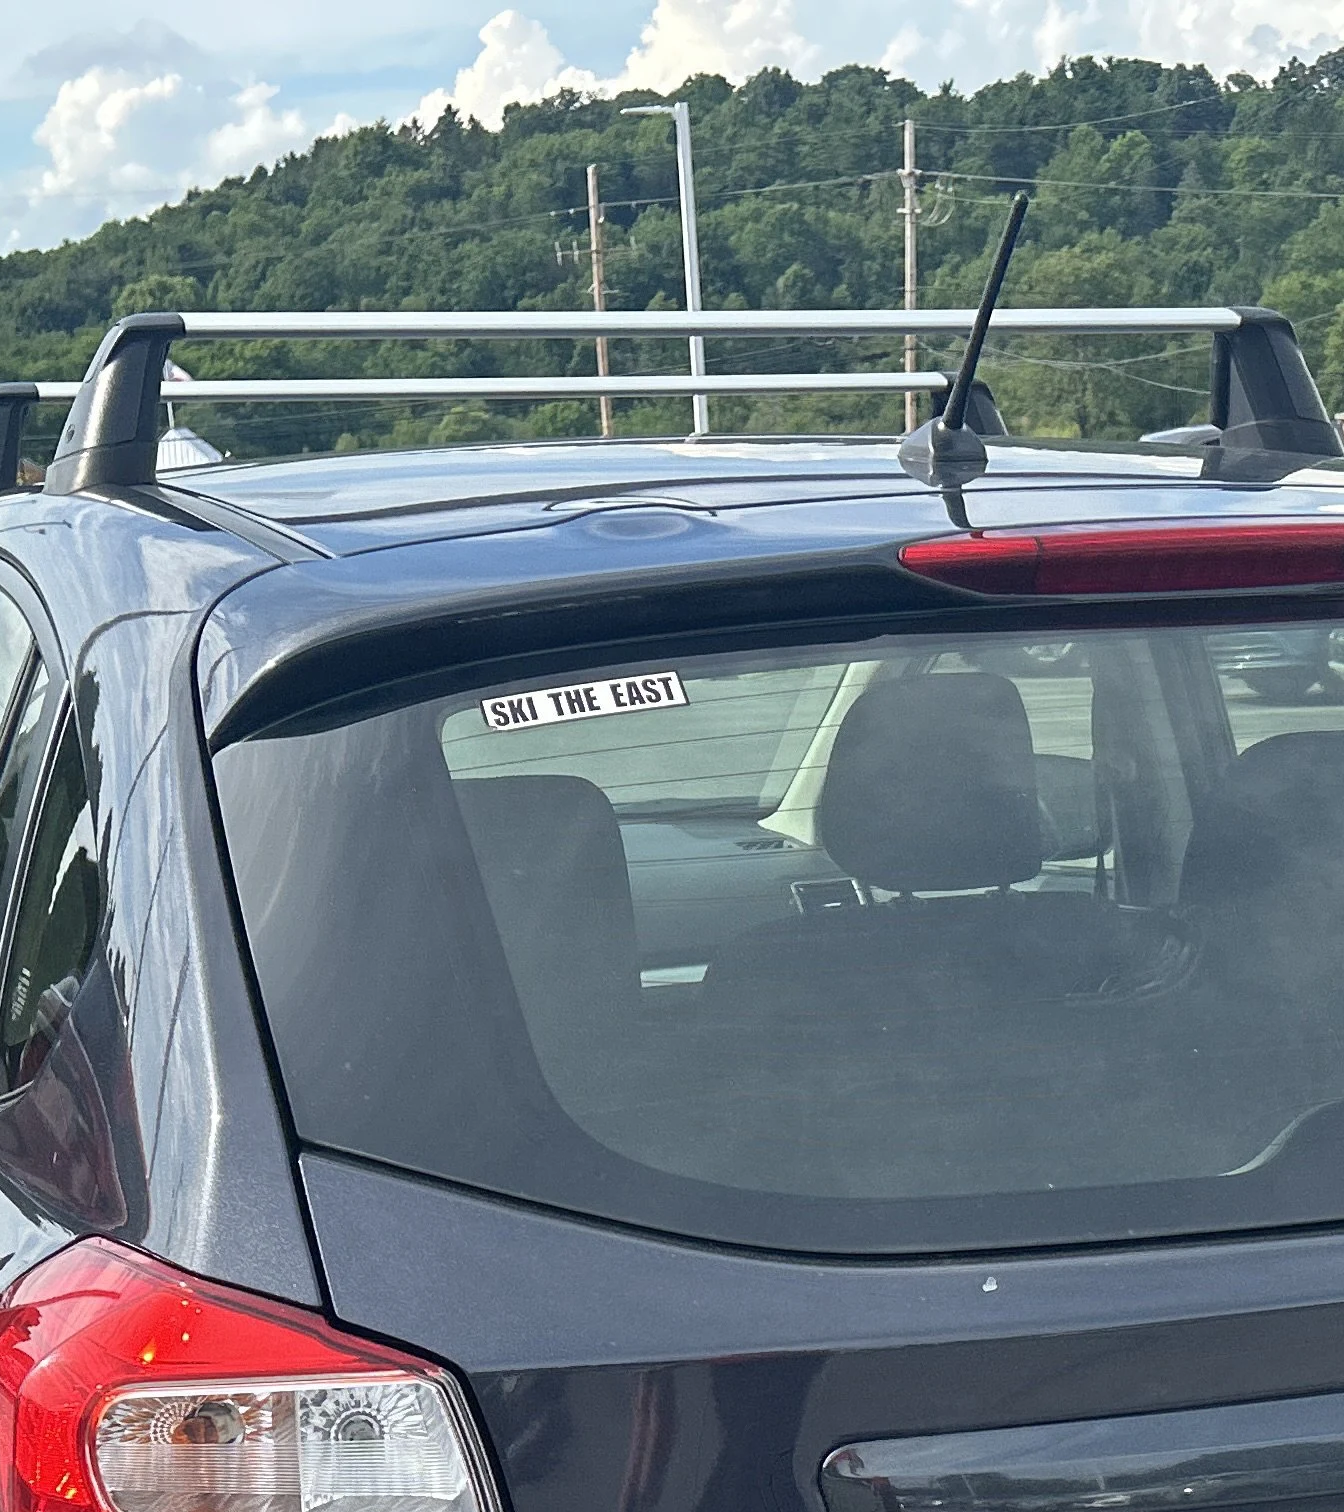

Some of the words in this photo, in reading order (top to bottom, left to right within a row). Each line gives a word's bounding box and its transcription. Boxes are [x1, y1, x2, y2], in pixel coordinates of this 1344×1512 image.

[490, 696, 539, 727] SKI
[547, 686, 601, 717] THE
[609, 676, 676, 708] EAST
